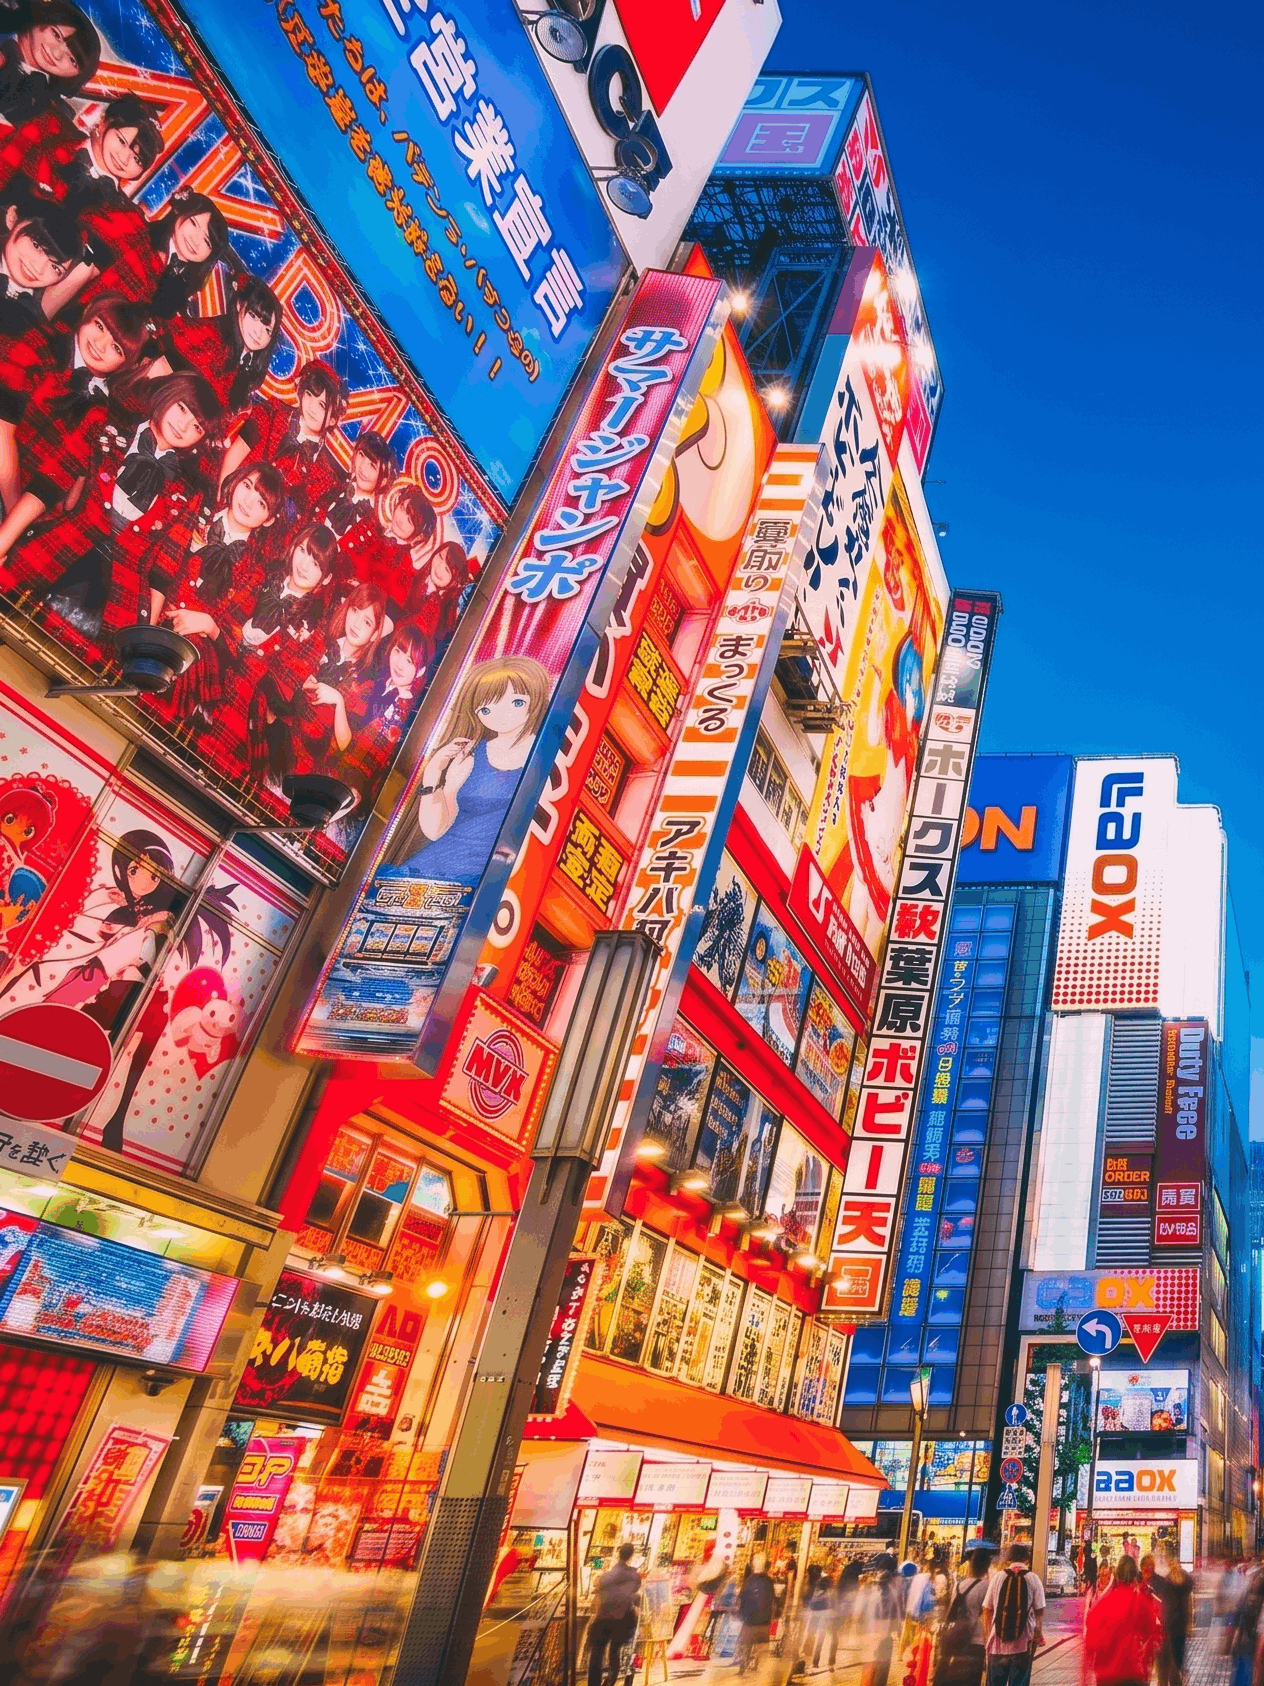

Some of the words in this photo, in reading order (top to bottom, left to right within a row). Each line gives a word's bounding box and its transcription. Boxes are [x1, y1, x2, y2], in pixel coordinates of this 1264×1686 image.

[506, 327, 688, 602] サマージャンボ
[698, 635, 753, 732] まっくる
